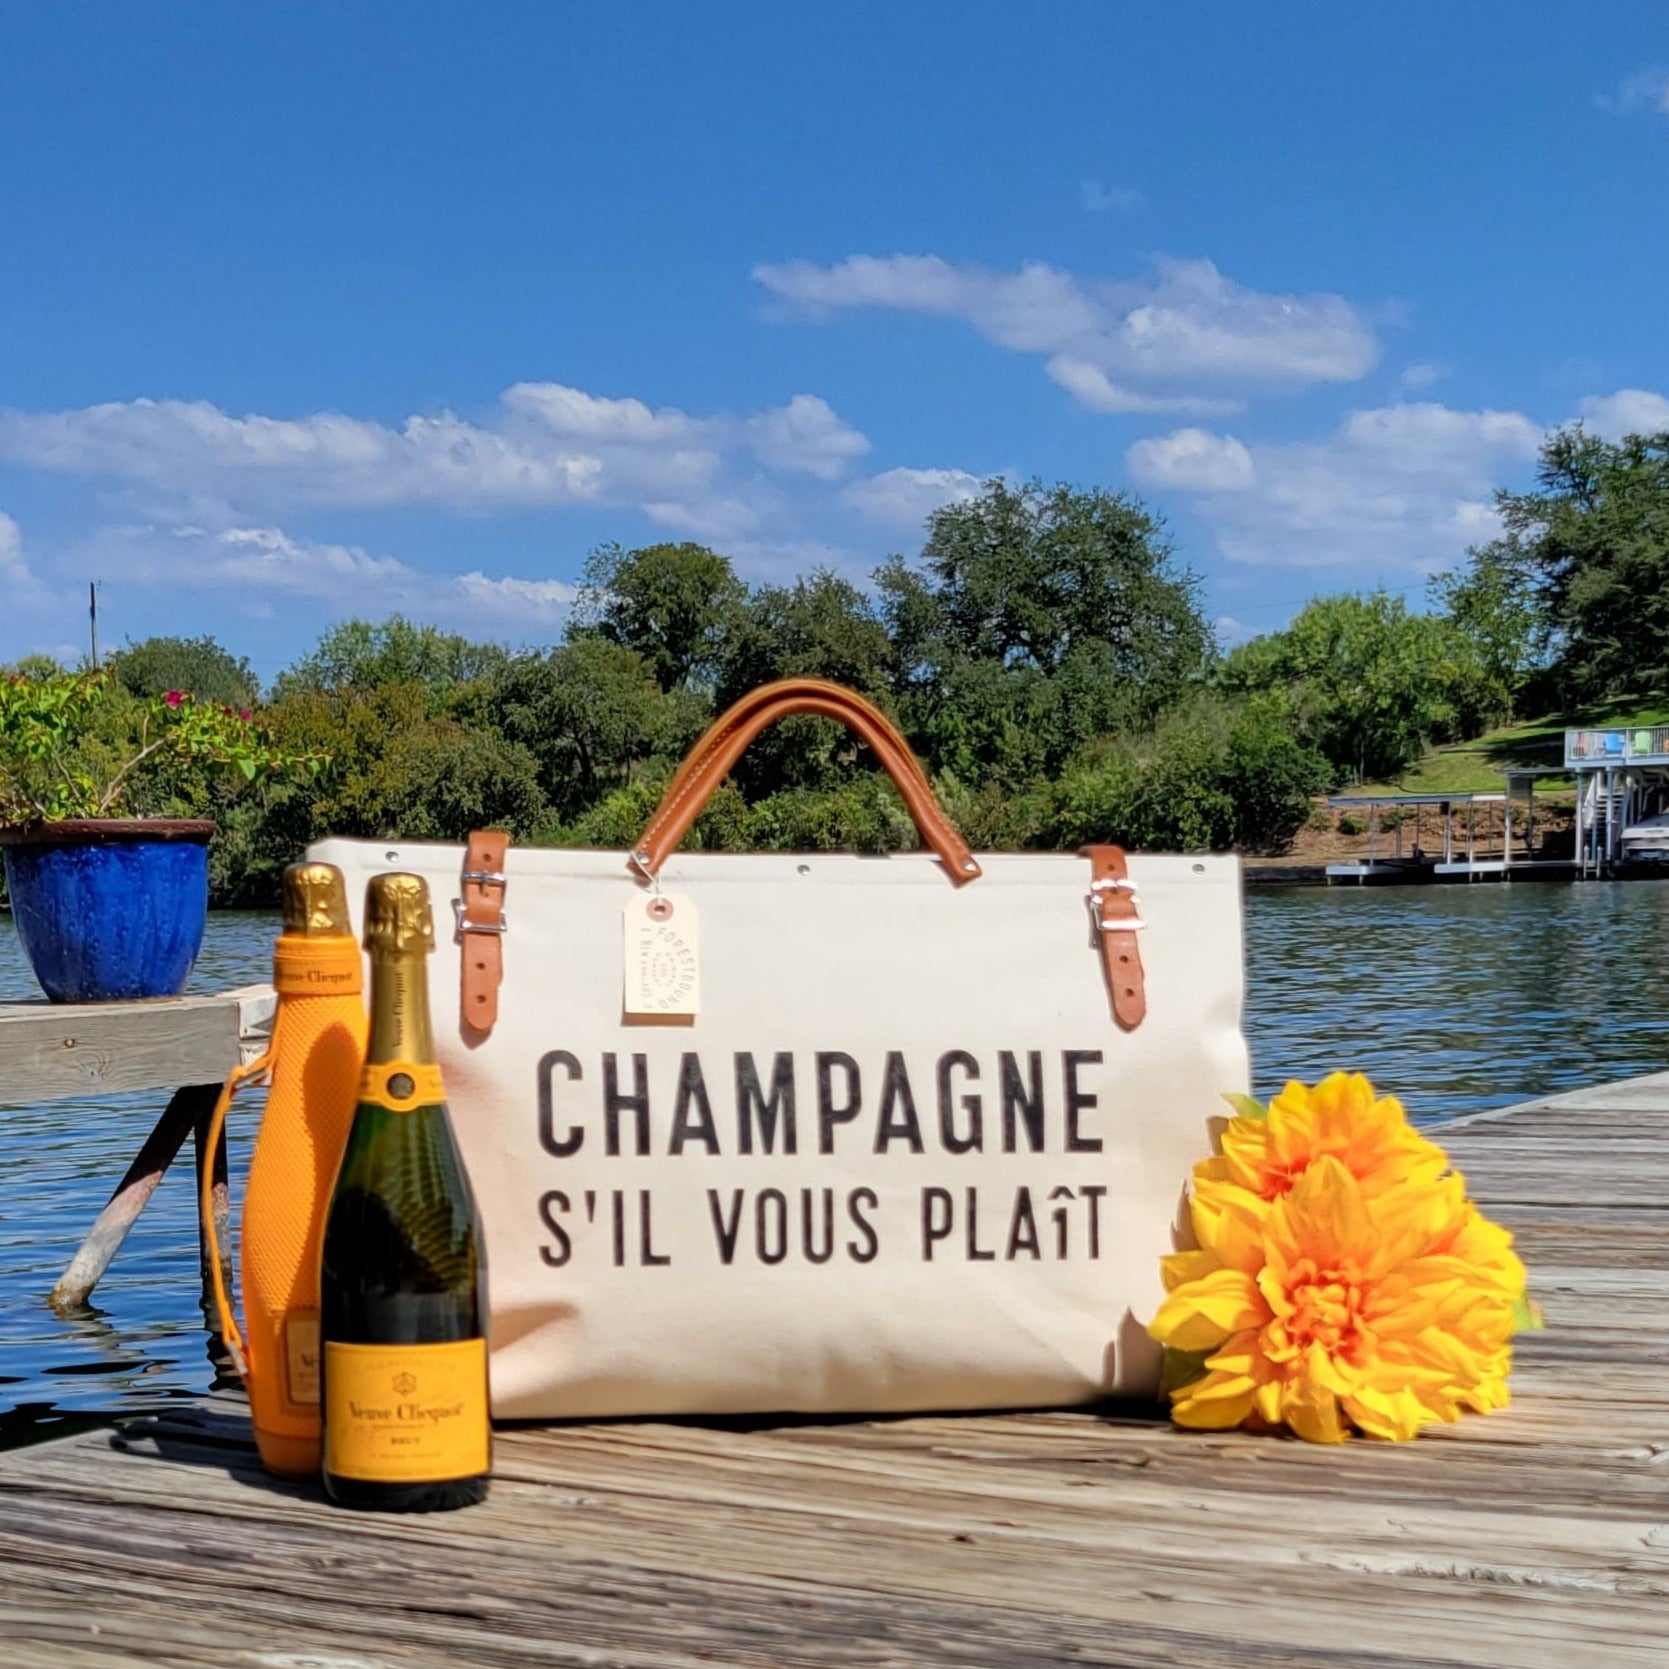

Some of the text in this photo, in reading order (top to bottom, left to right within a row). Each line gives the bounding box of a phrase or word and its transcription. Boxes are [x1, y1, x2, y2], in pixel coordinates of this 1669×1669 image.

[536, 1049, 1104, 1158] CHAMPAGNE
[538, 1190, 671, 1267] S'IL
[707, 1187, 879, 1265] VOUS
